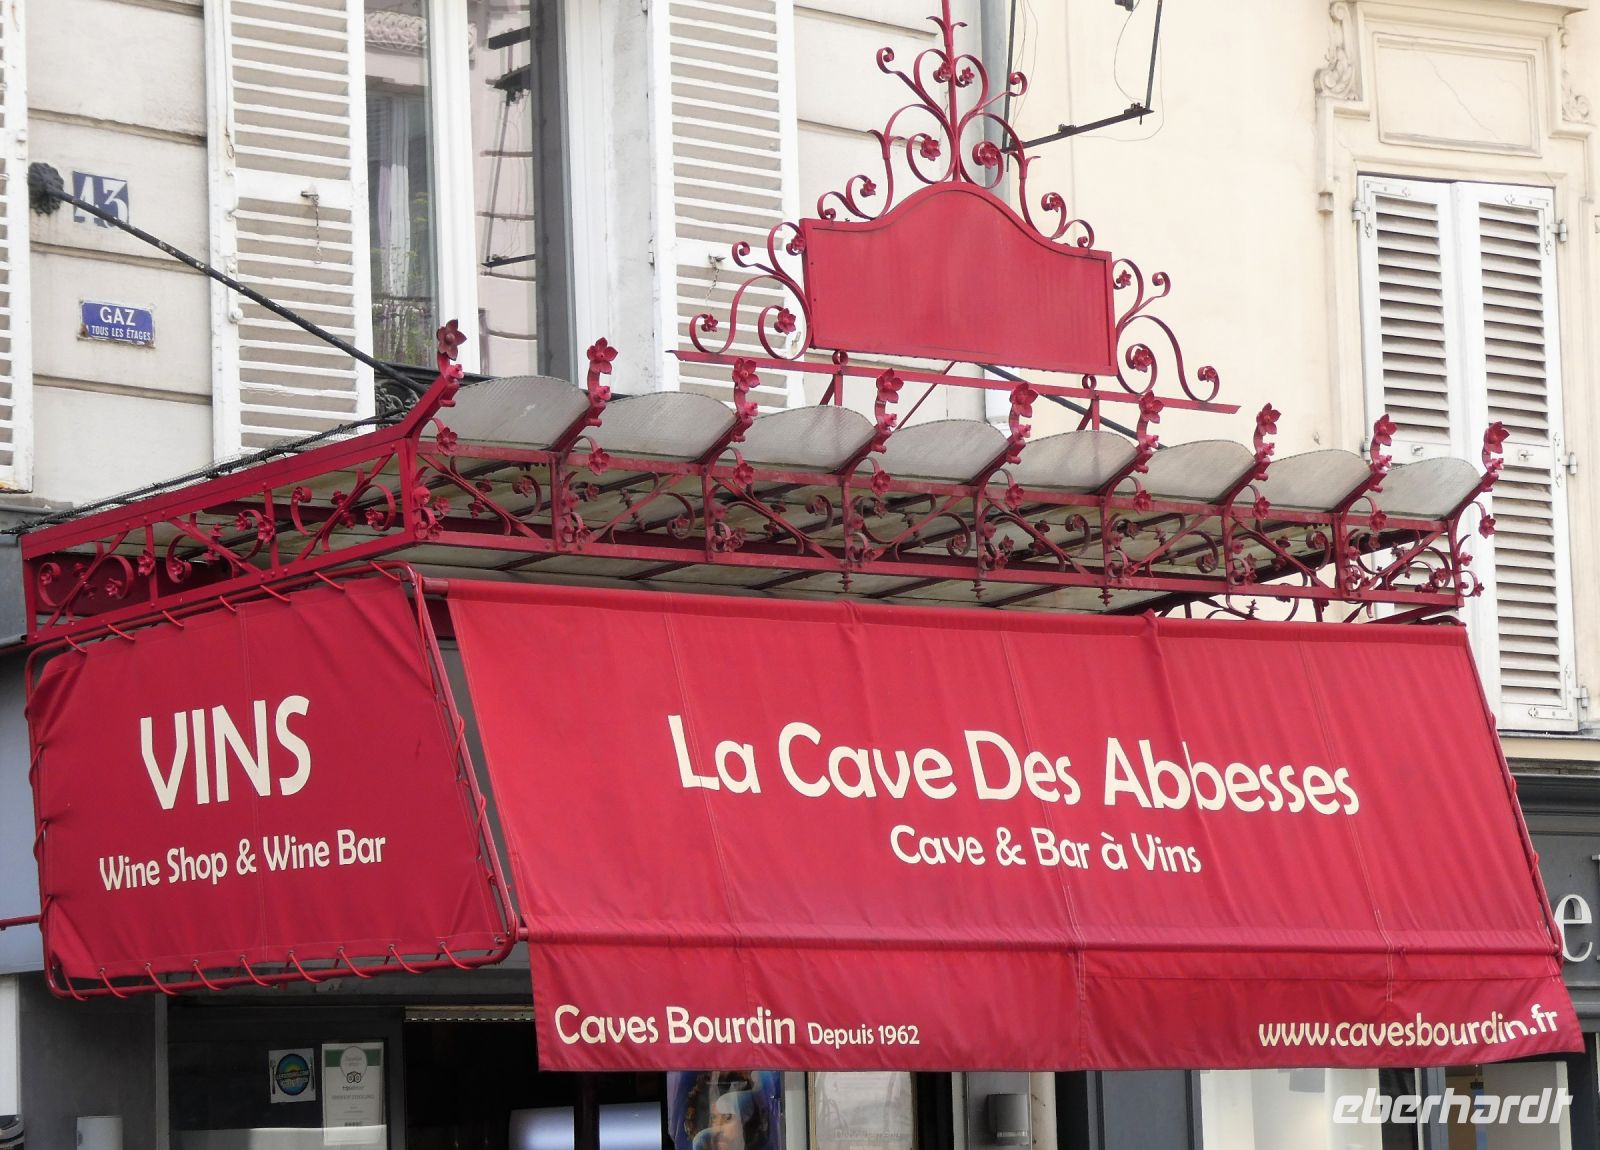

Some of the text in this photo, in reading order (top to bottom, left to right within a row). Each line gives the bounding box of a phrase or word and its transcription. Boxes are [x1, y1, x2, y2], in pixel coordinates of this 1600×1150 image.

[74, 176, 128, 229] 43
[91, 325, 109, 337] TOUS
[111, 327, 124, 338] LES
[126, 327, 151, 341] ÉTAGES
[100, 306, 136, 326] GAZ
[140, 695, 311, 810] VINS
[668, 714, 1360, 815] La Cave Des Abbesses
[99, 829, 386, 891] Wine Shop & Wine Bar
[890, 824, 1202, 873] Cave & Bar à Vins
[554, 1004, 920, 1049] Caves Bourdin Depuis 1962
[1258, 1003, 1558, 1047] www.cavesbourdin.fr
